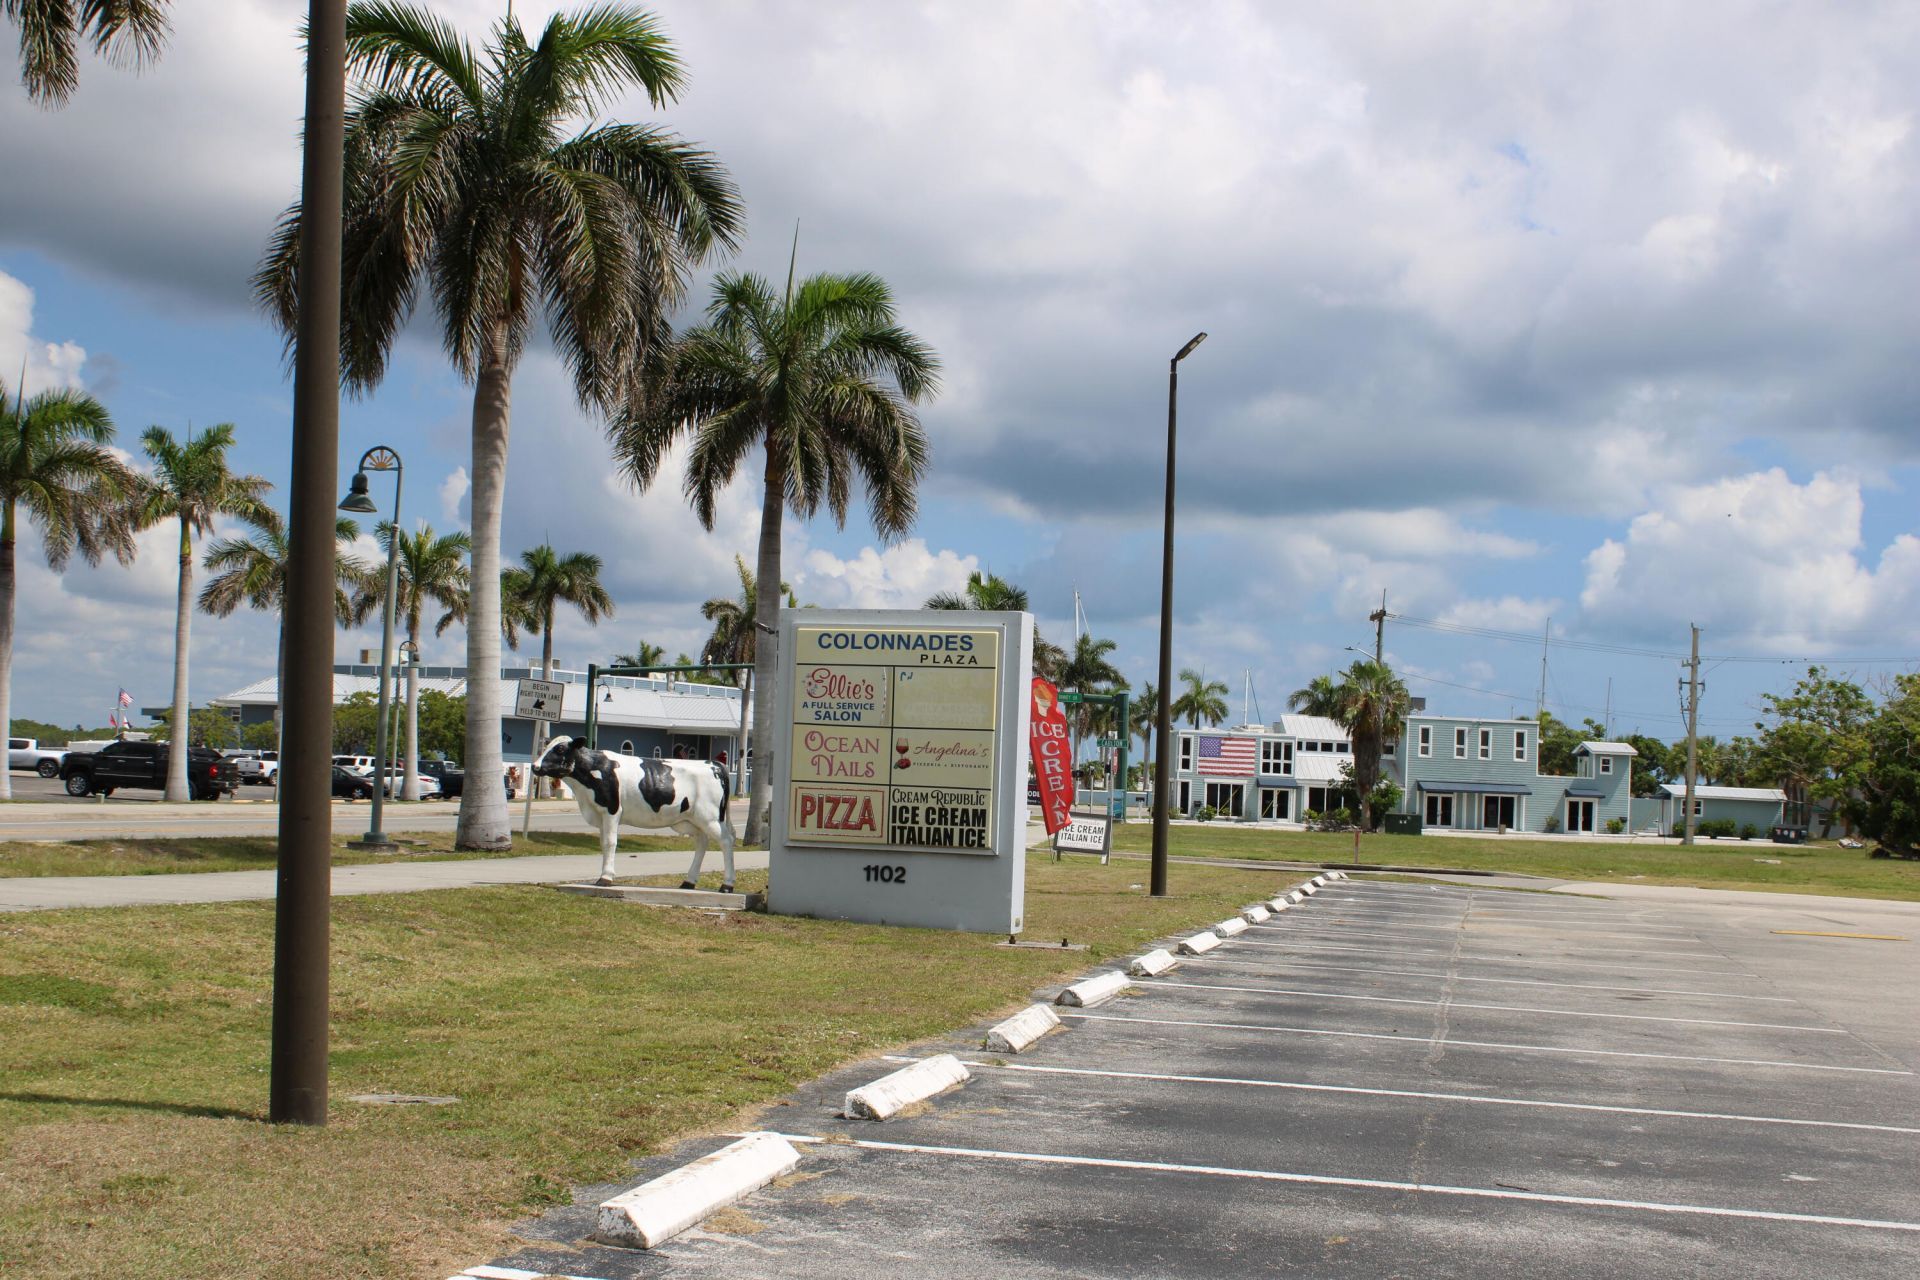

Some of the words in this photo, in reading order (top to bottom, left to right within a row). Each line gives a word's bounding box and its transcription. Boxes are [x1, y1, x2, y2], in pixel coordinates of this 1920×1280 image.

[817, 632, 974, 652] COLONNADES
[920, 653, 978, 665] PLAZA
[532, 683, 550, 691] BEGIN
[807, 667, 875, 700] Ellie's
[520, 690, 534, 698] RIGHT
[534, 691, 547, 699] TURN
[548, 694, 561, 702] LANE
[520, 708, 534, 716] YIELD
[535, 709, 541, 717] TO
[542, 710, 557, 719] BIKES
[811, 702, 835, 710] FULL
[836, 702, 875, 711] SERVICE
[814, 710, 862, 722] SALON
[1030, 720, 1066, 739] ICE
[804, 730, 880, 754] OCEAN
[913, 741, 990, 762] Angelina's
[810, 754, 875, 778] NAILS
[892, 788, 929, 804] CREAM
[800, 792, 877, 832] PIZZA
[891, 805, 919, 825] ICE
[925, 806, 987, 828] CREAM
[891, 825, 954, 847] ITALIAN
[958, 827, 986, 848] ICE
[1060, 832, 1088, 843] ITALIAN
[1090, 834, 1103, 844] ICE
[1077, 824, 1104, 835] CREAM
[863, 864, 906, 884] 1102
